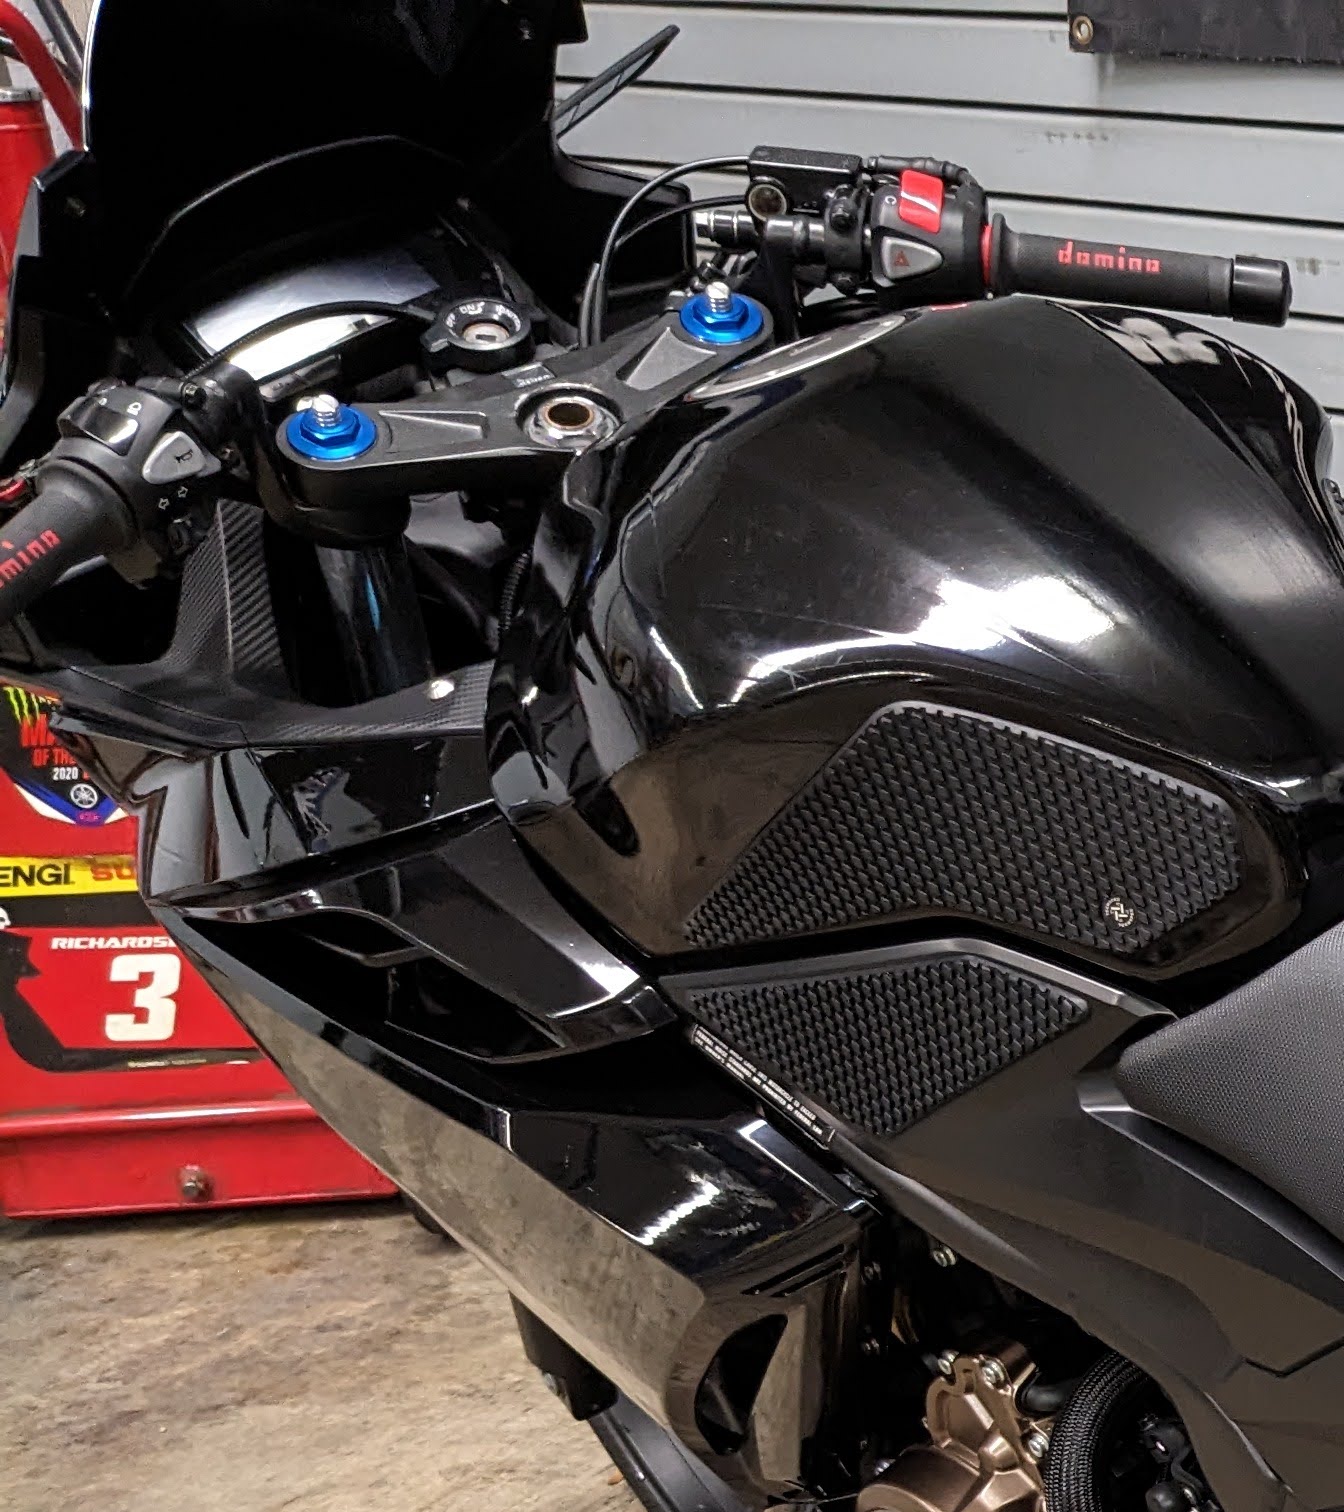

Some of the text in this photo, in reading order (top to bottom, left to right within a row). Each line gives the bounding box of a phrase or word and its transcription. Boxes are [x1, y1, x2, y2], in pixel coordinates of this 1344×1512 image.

[1058, 240, 1161, 273] domino
[33, 748, 50, 768] OF
[52, 766, 79, 781] 2020
[104, 953, 182, 1042] 3
